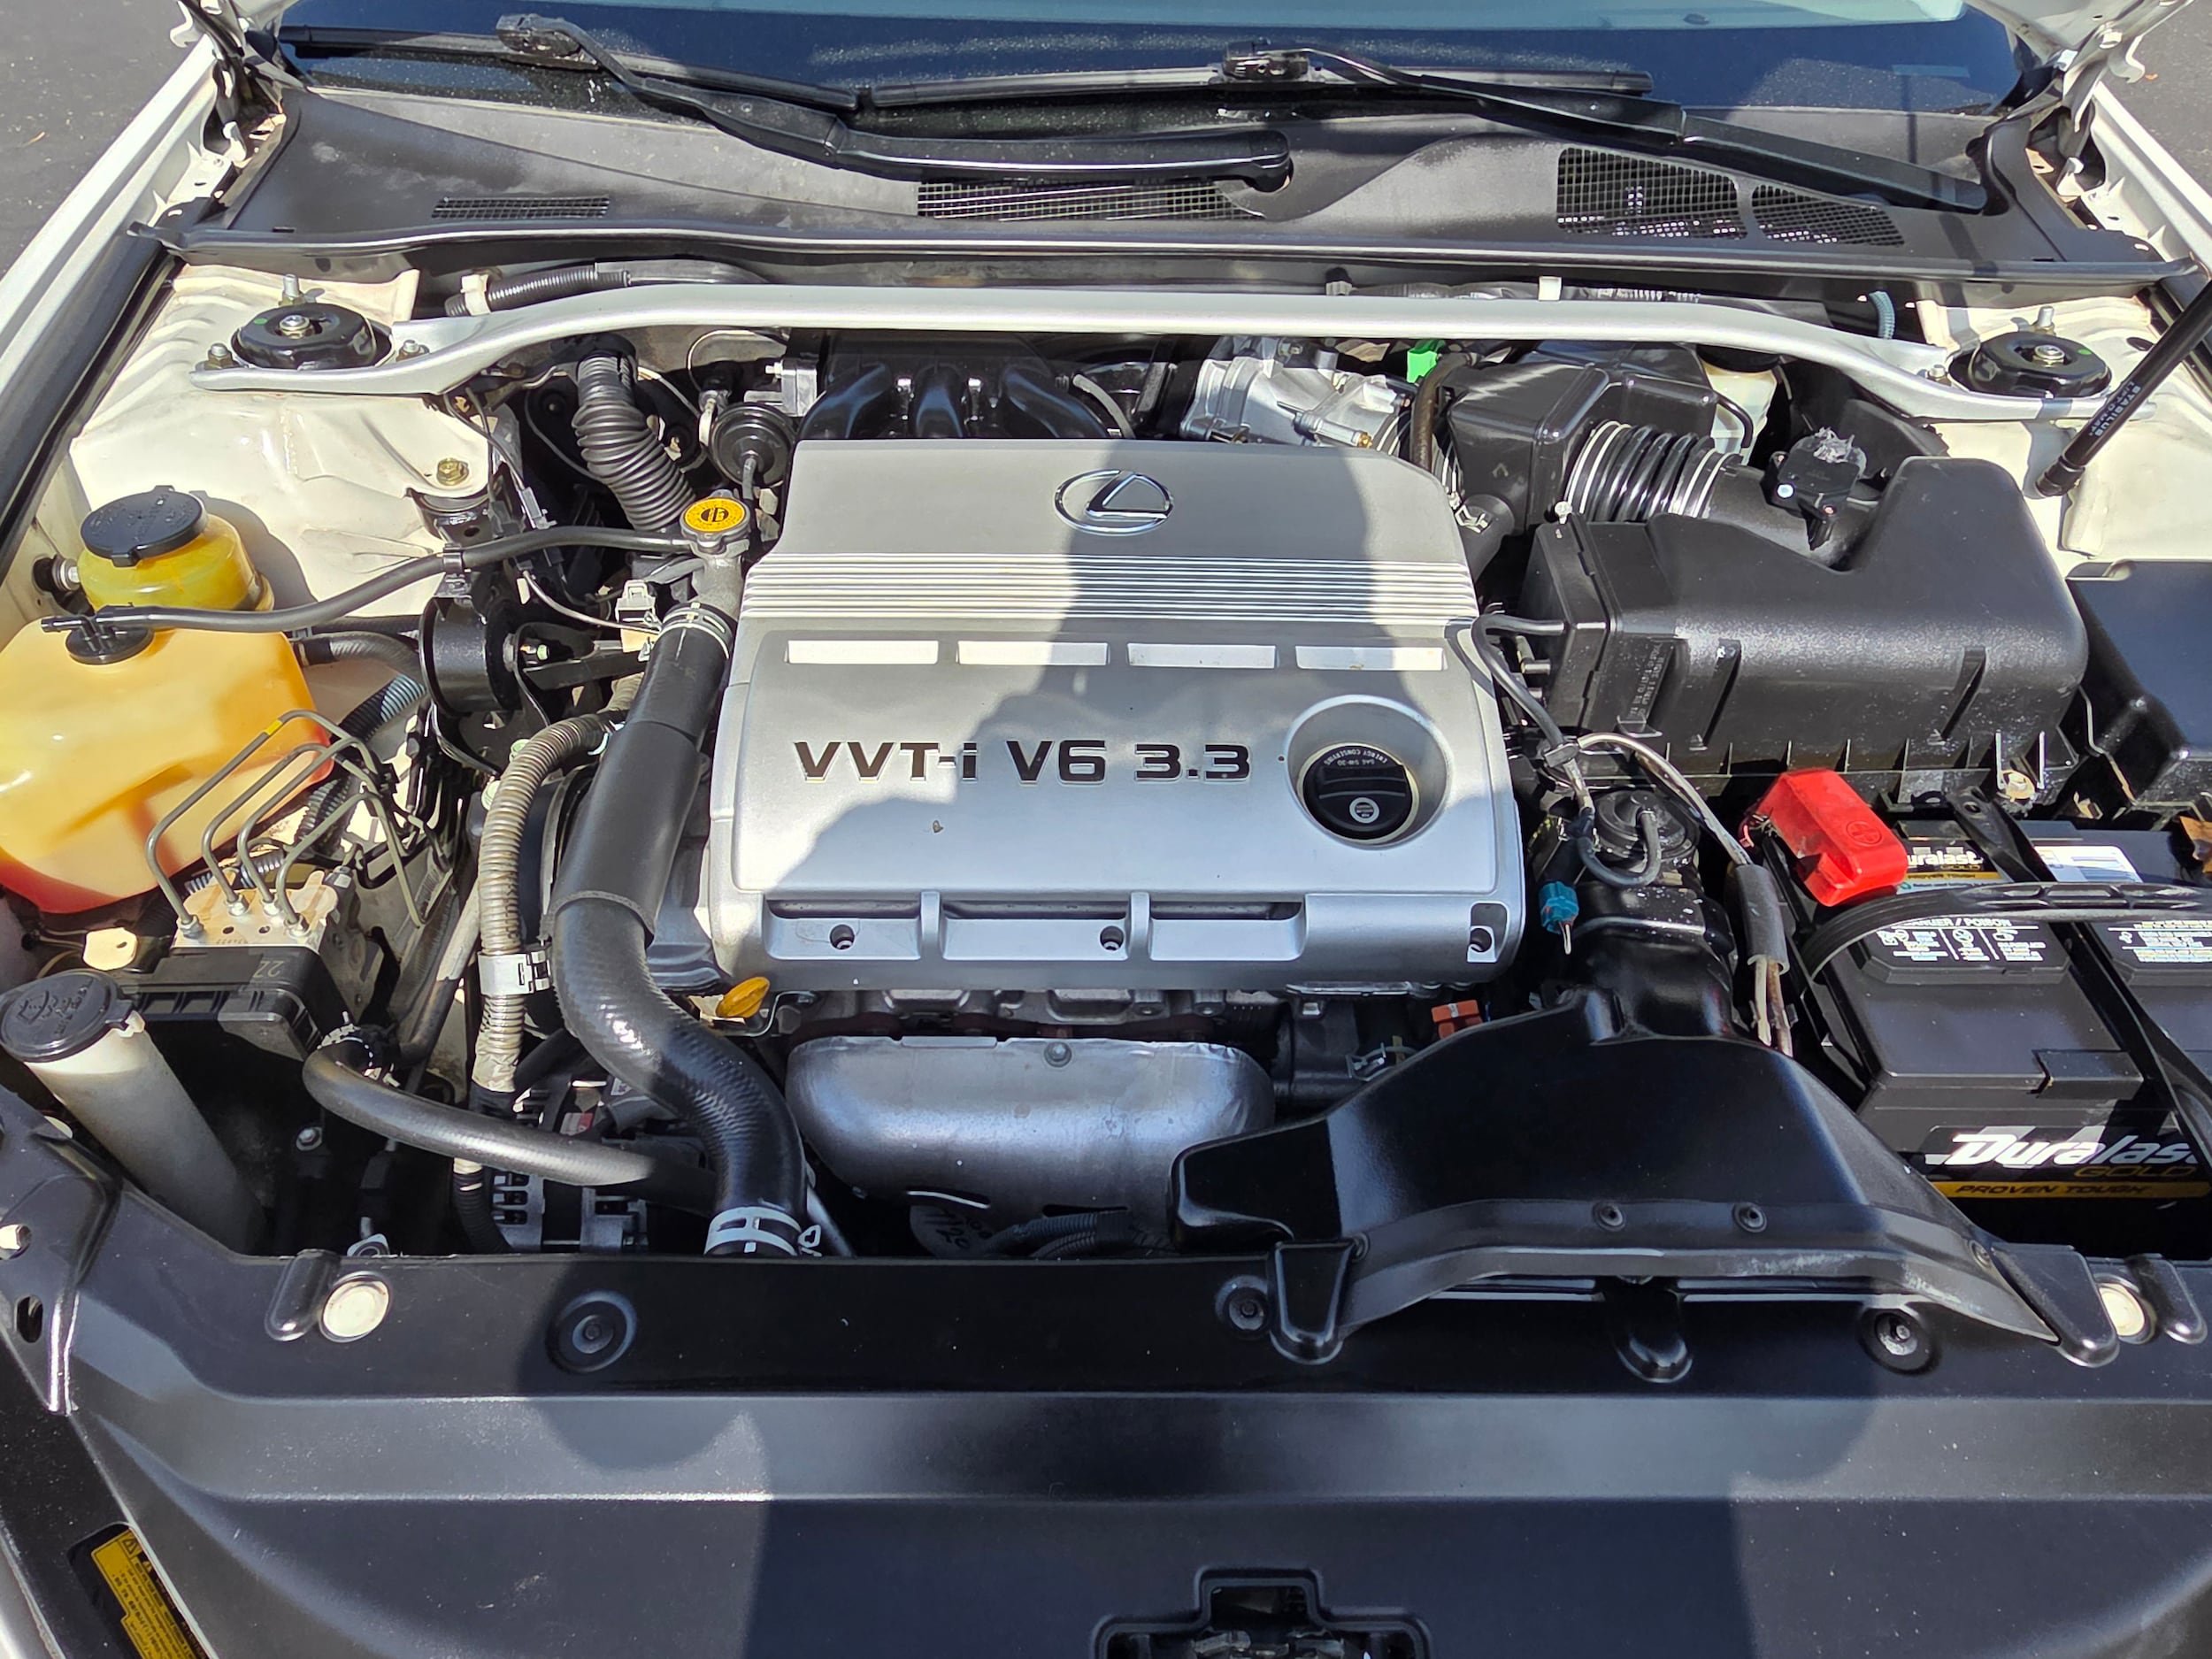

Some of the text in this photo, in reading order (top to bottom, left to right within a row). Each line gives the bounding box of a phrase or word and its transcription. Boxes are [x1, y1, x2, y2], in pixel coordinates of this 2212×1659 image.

[2094, 385, 2141, 436] STABILUS
[794, 740, 1250, 783] VVT-i V6 3.3
[1324, 749, 1387, 765] ENERGY CONSERVING
[1907, 850, 1984, 866] uralast
[1946, 1134, 2198, 1166] Duralas
[2074, 1165, 2197, 1178] GOLD
[1955, 1185, 2148, 1194] PROVEN TOUGH
